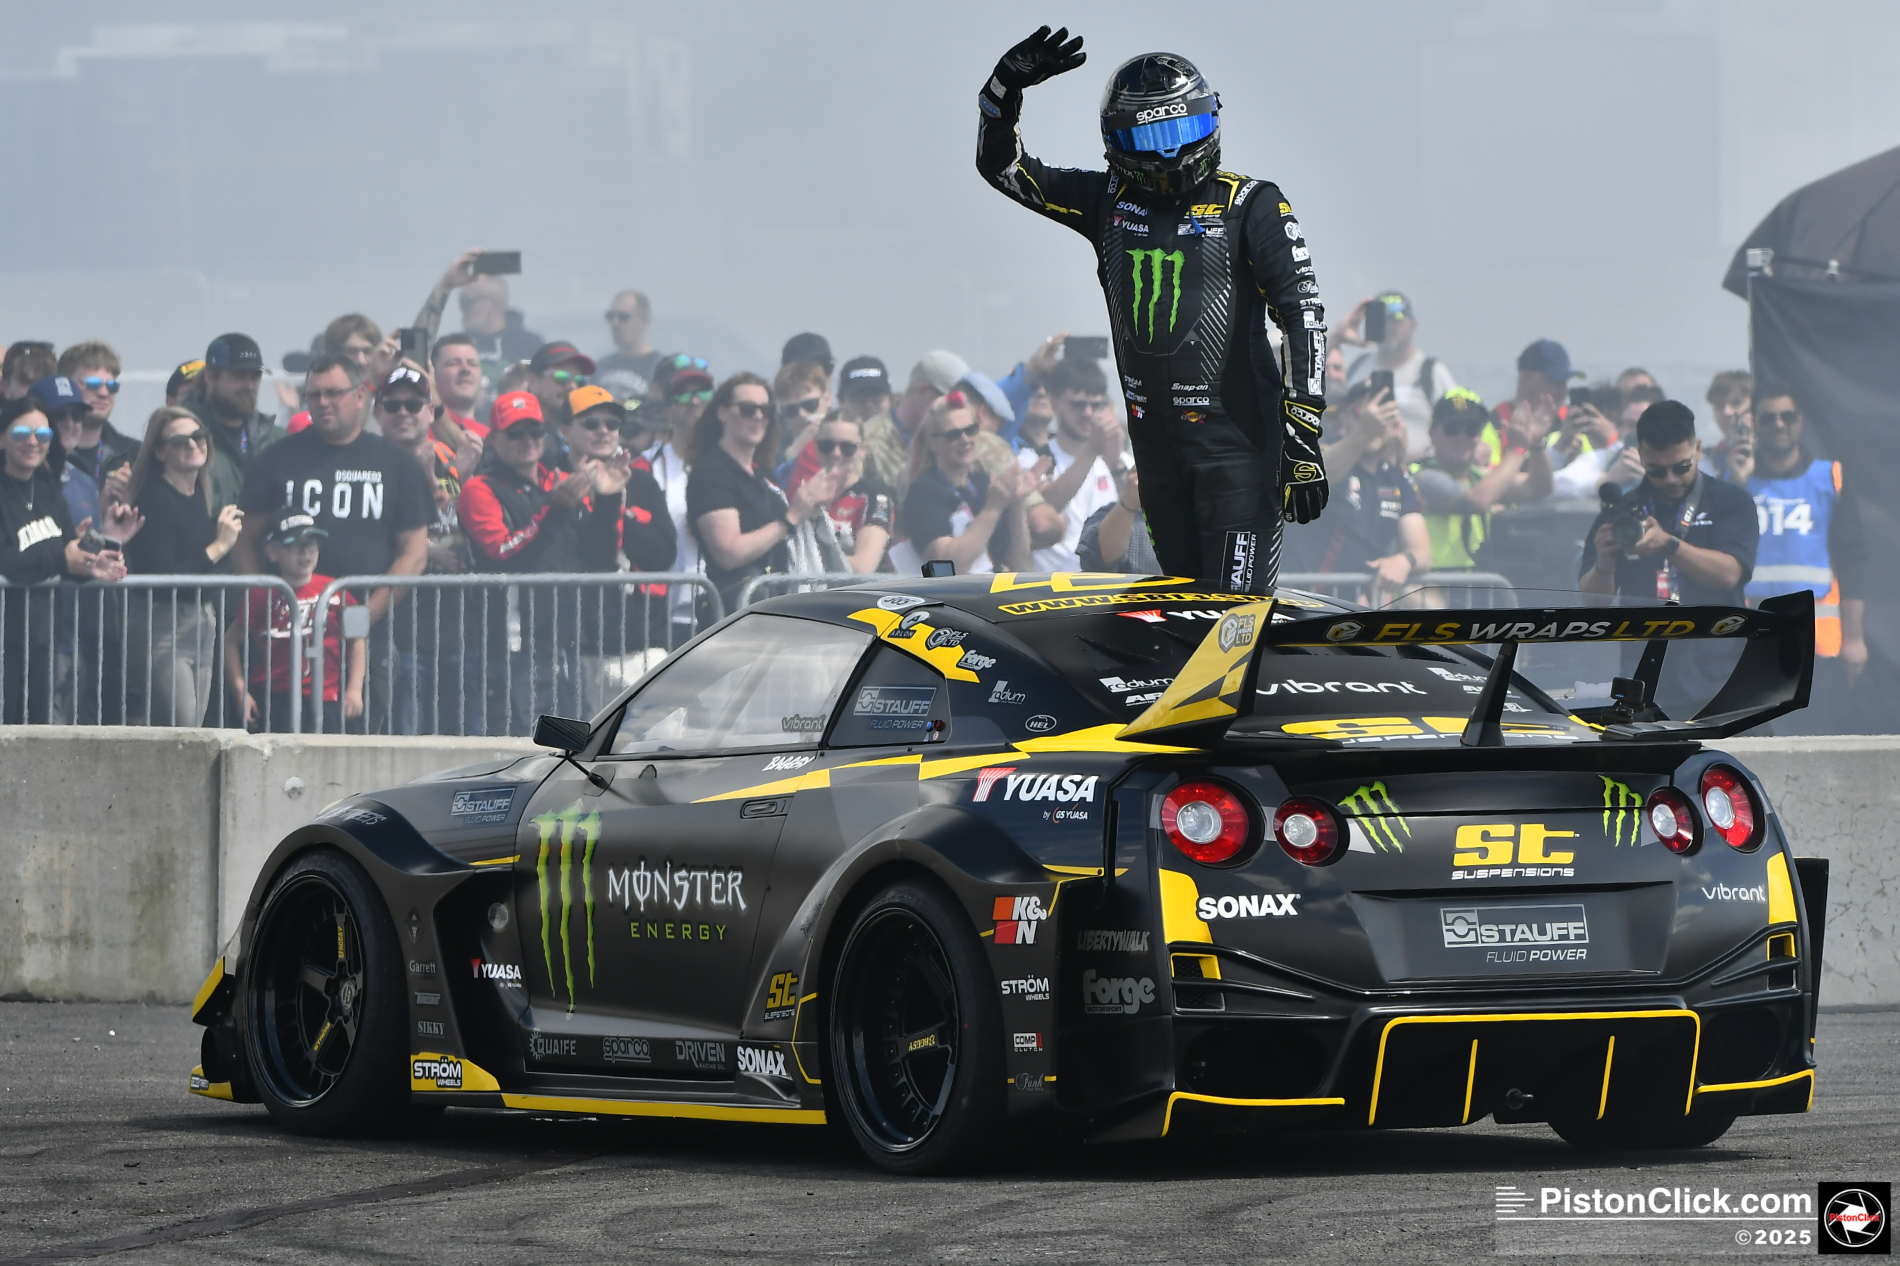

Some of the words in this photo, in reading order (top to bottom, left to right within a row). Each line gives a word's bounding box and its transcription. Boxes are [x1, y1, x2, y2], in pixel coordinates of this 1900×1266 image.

[1136, 104, 1187, 124] sparco
[1116, 201, 1148, 217] SONA
[1122, 220, 1149, 233] YUASA
[1171, 383, 1209, 391] Snap-on
[1173, 397, 1210, 406] sparco
[286, 478, 384, 520] ICON
[1248, 534, 1257, 568] POWER
[1238, 616, 1254, 629] FLS
[889, 629, 915, 637] ARLON
[1373, 622, 1461, 642] FLS
[1468, 621, 1612, 640] WRAPS
[1612, 620, 1696, 638] LTD
[1235, 633, 1252, 645] LTD
[1256, 679, 1428, 695] vibrant
[873, 700, 930, 714] STAUFF
[782, 716, 823, 730] vibrant
[868, 719, 893, 729] FLUID
[891, 720, 924, 729] POWER
[1029, 720, 1049, 729] HEL
[1003, 774, 1099, 802] YUASA
[467, 798, 511, 812] STAUFF
[481, 813, 507, 823] POWER
[1055, 810, 1065, 819] GS
[1065, 811, 1088, 820] YUASA
[1451, 867, 1575, 881] SUSPENSIONS
[608, 860, 747, 913] MONSTER
[1701, 882, 1766, 902] vibrant
[630, 921, 727, 941] ENERGY
[1480, 922, 1586, 943] STAUFF
[1486, 950, 1527, 963] FLUID
[1529, 949, 1588, 962] POWER
[409, 959, 437, 974] Garrett
[481, 963, 523, 980] YUASA
[1001, 975, 1050, 995] STRÖM
[1025, 992, 1051, 1001] WHEELS
[417, 1020, 445, 1035] SIKKY
[537, 1038, 577, 1057] QUAIFE
[602, 1037, 652, 1062] sparco
[676, 1040, 726, 1067] DRIVEN
[413, 1058, 462, 1078] STRÖM
[737, 1045, 787, 1077] SONAX
[437, 1078, 462, 1087] WHEELS
